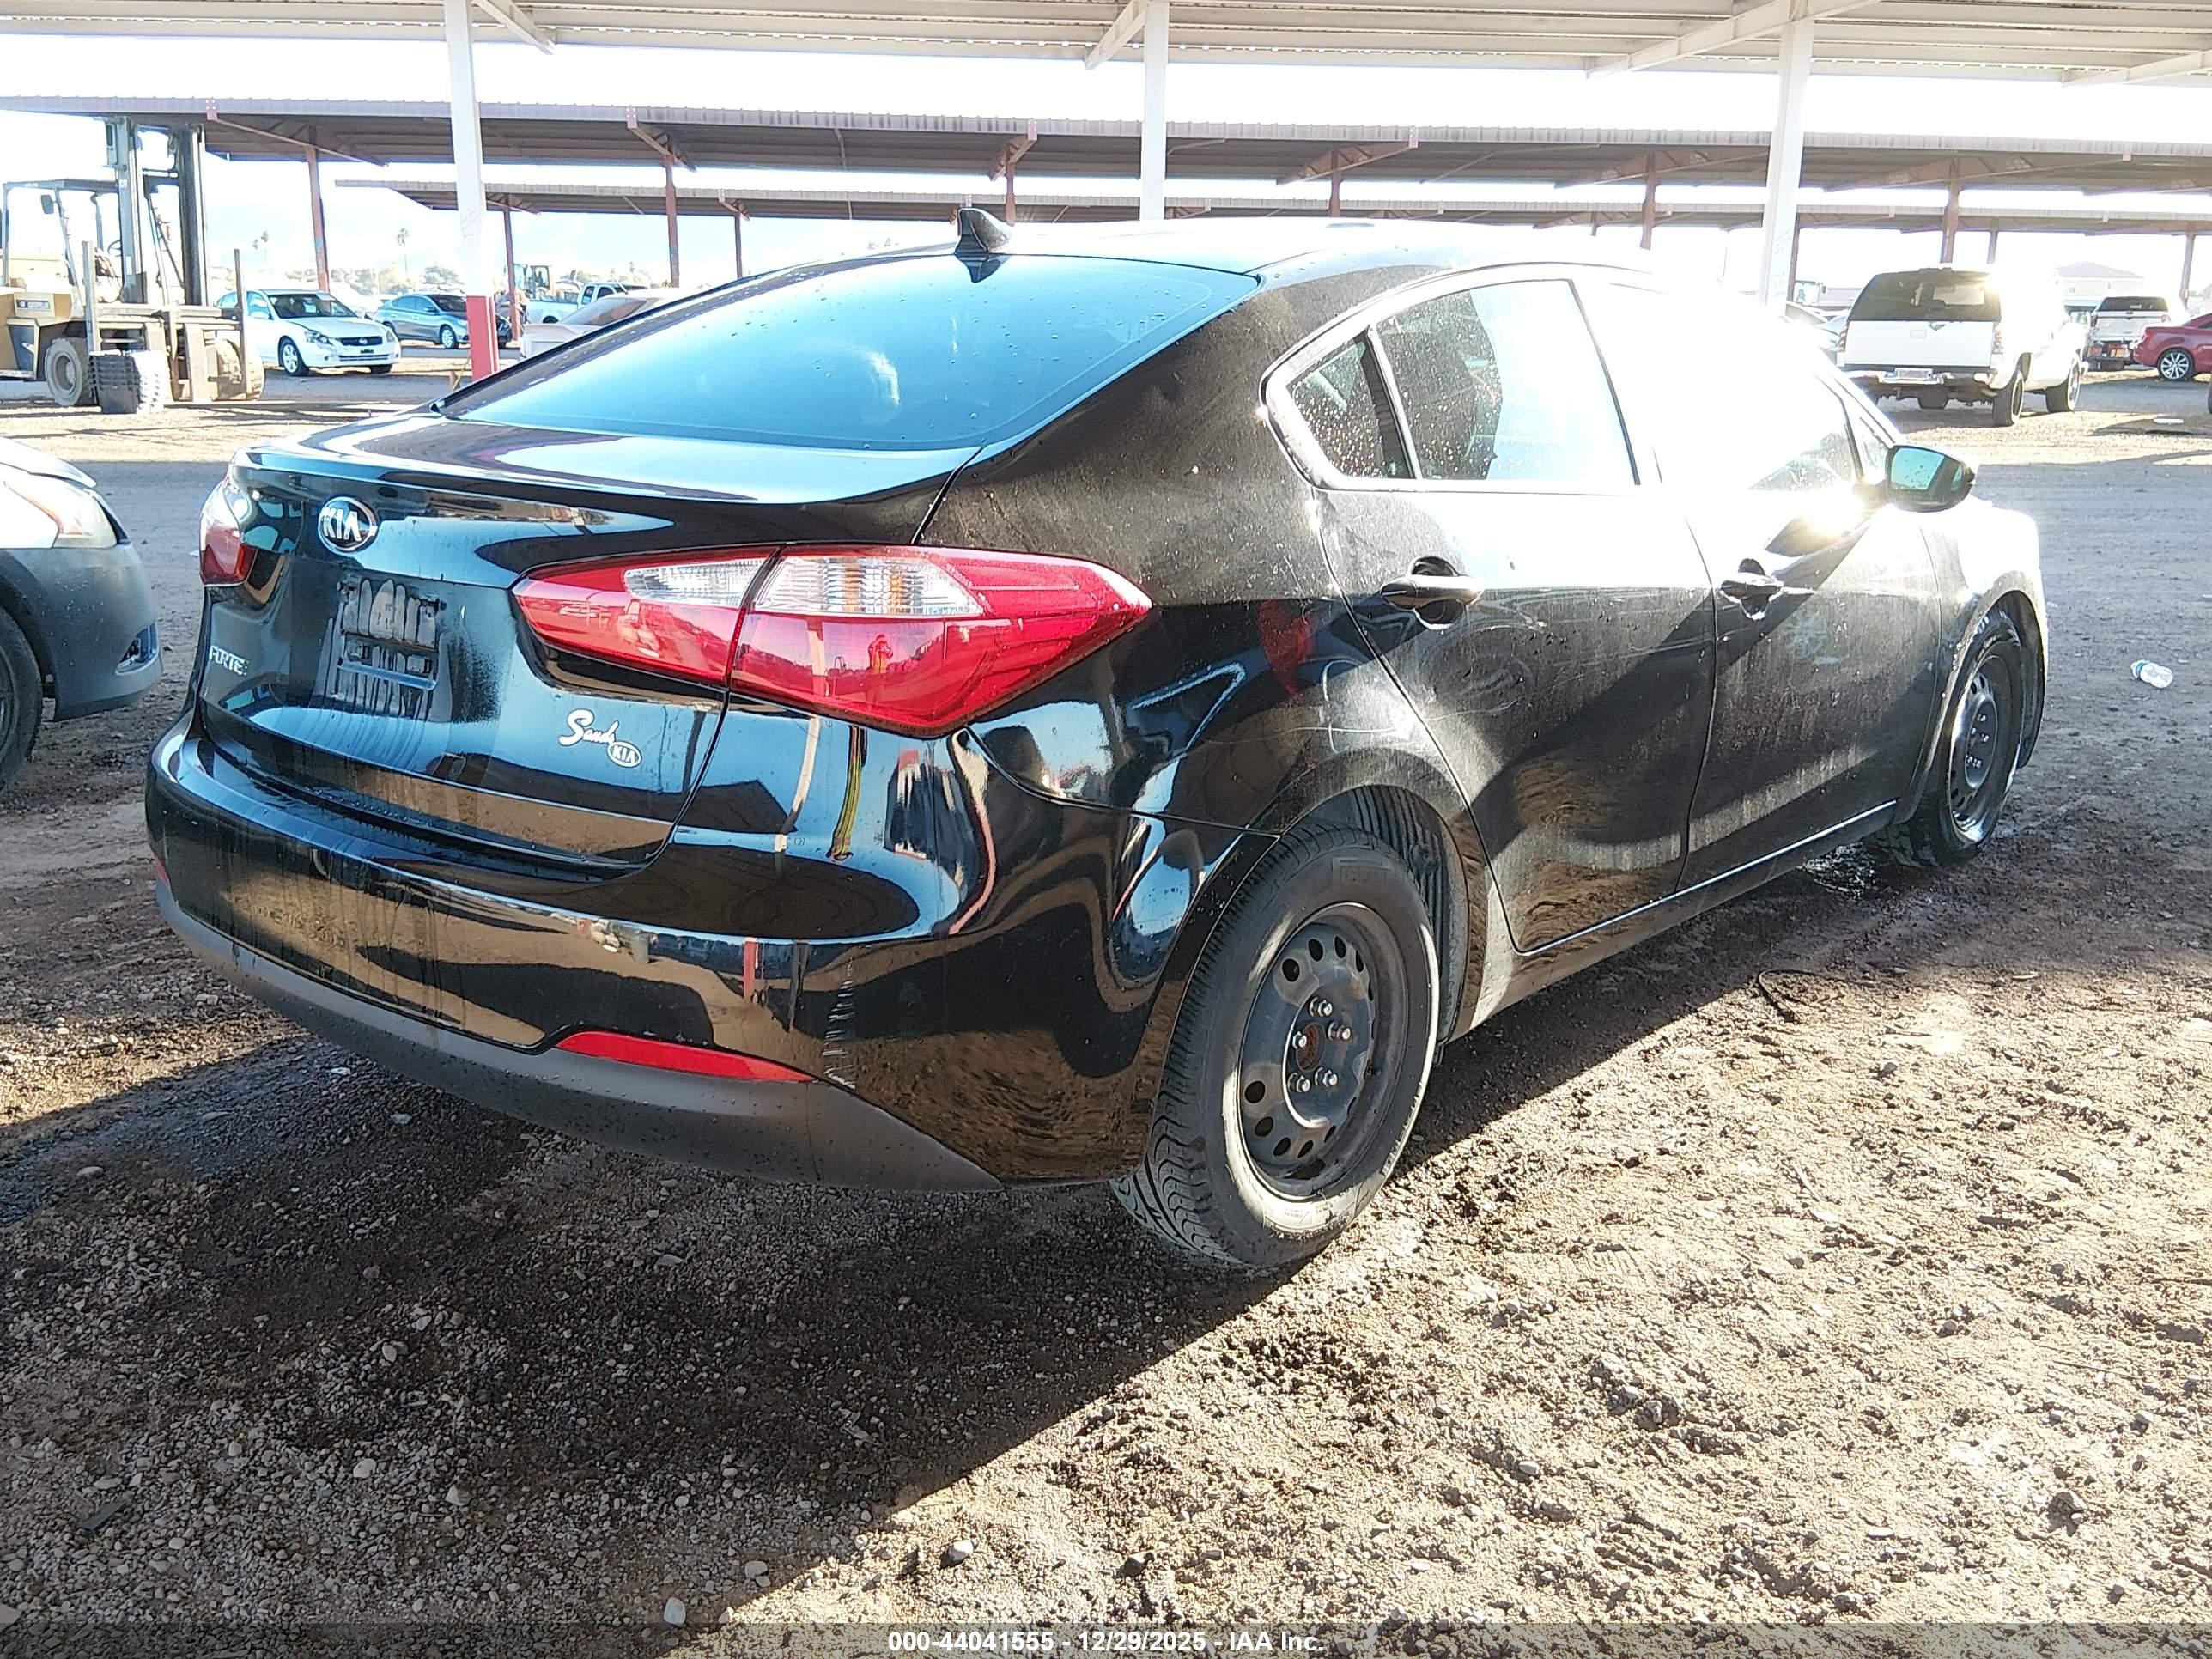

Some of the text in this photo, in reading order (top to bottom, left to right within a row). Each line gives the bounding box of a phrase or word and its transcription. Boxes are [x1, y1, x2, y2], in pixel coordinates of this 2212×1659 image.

[320, 507, 362, 542] KIA
[209, 645, 248, 676] FORTE
[611, 744, 636, 765] KIA
